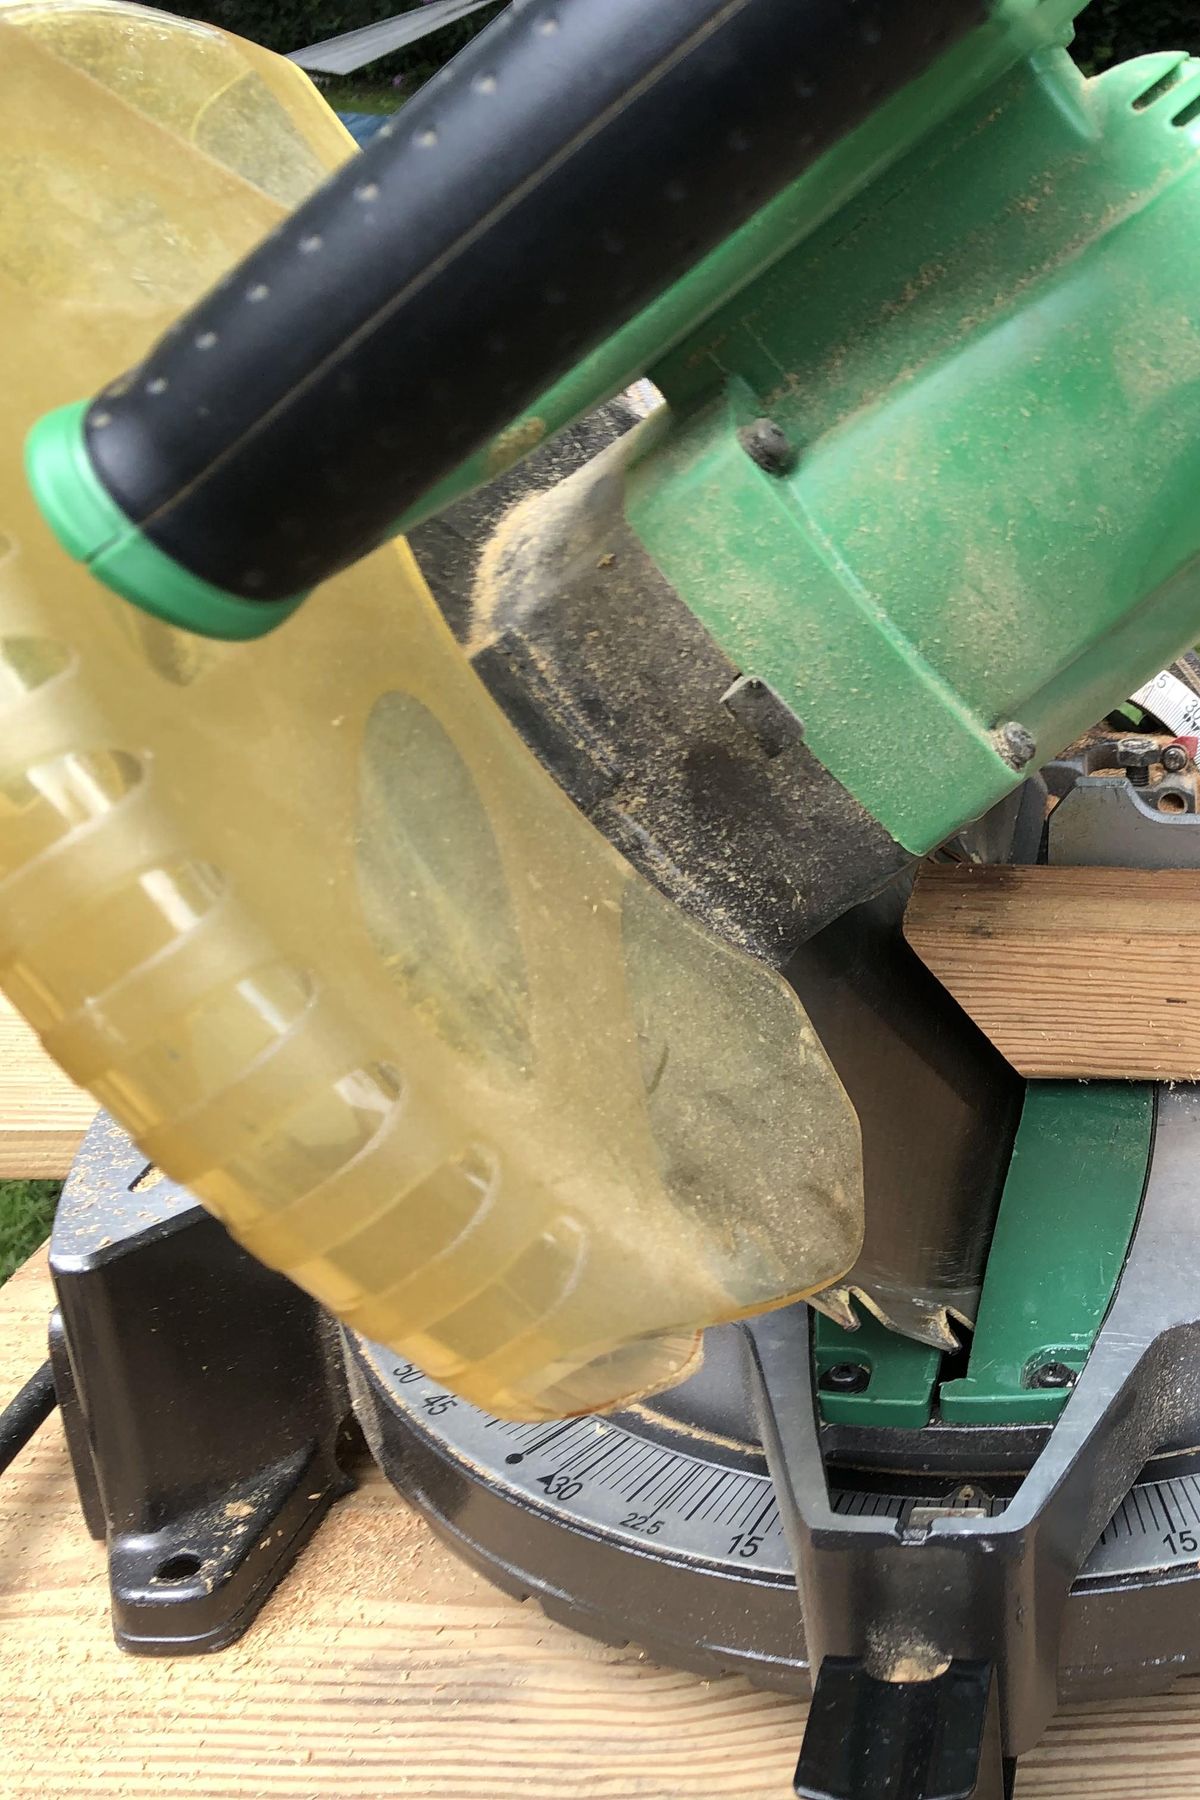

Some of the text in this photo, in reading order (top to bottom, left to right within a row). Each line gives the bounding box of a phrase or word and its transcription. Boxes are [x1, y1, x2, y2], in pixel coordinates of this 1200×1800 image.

[1151, 673, 1170, 689] 5
[422, 1394, 458, 1416] 45
[543, 1476, 584, 1501] 30
[619, 1512, 666, 1536] 22.5
[726, 1533, 765, 1558] 15
[1162, 1530, 1198, 1556] 15
